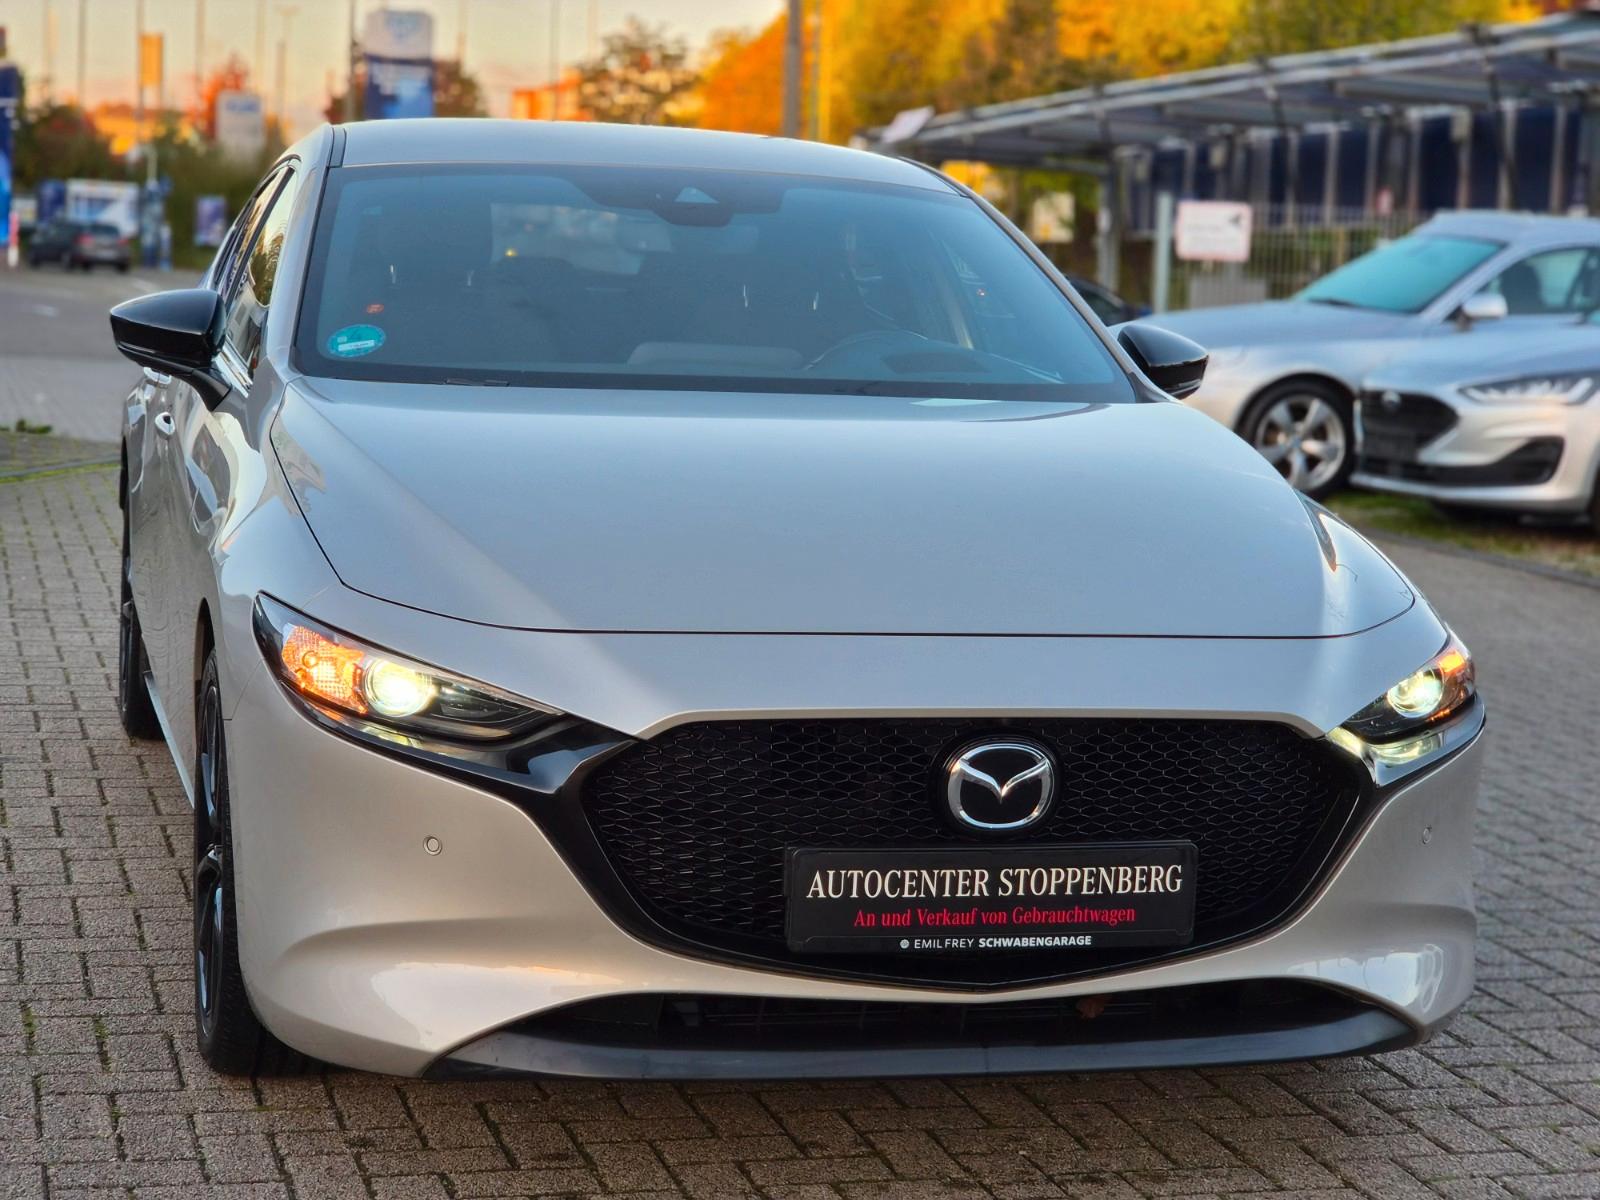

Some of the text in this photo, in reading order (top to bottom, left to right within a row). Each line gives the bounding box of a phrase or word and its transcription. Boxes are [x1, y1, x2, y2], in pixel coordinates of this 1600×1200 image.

[806, 864, 1183, 899] AUTOCENTER STOPPENBERG
[853, 905, 1136, 927] An und Verkauf von Gebrauchtwagen
[914, 935, 1092, 949] EMIL FREY SCHWABENGARAGE
